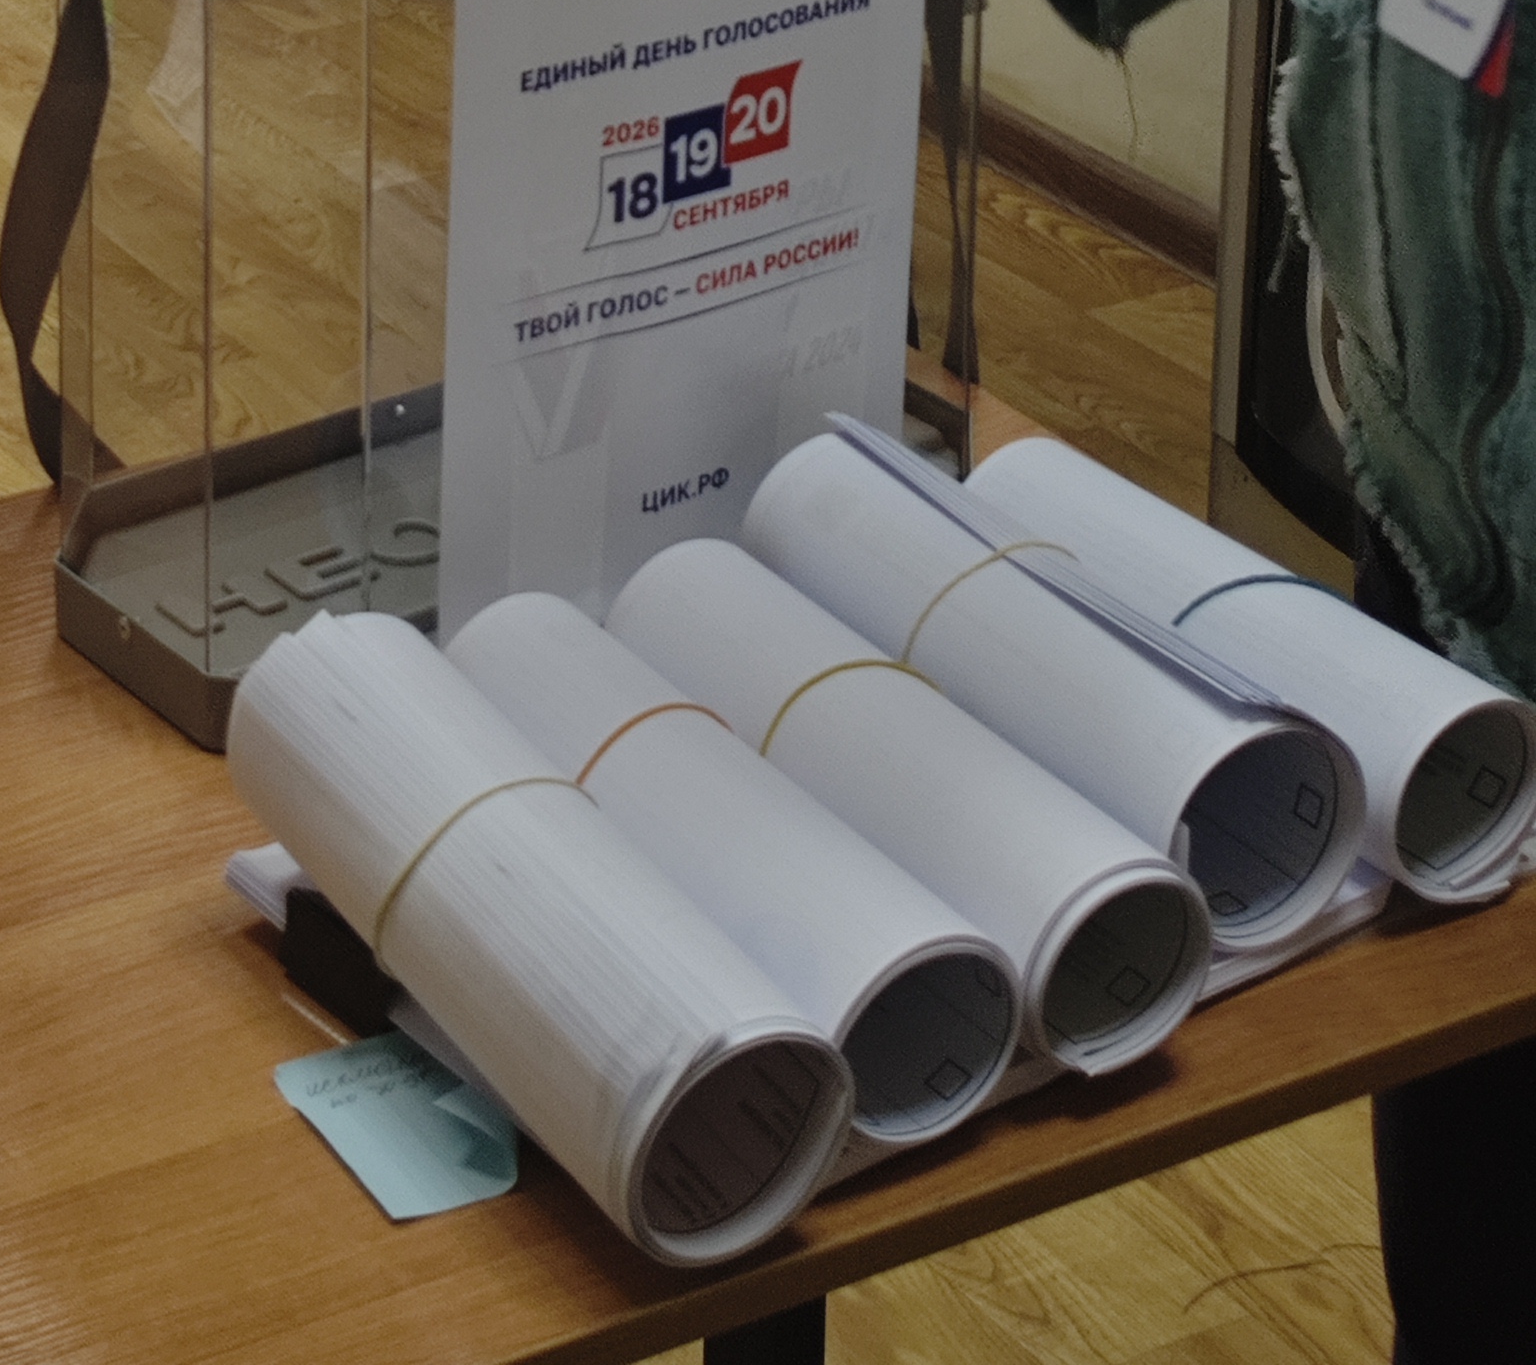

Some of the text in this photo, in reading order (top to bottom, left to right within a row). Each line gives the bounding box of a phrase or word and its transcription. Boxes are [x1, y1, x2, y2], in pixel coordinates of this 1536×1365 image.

[520, 43, 625, 93] ЕДИНЫЙ
[632, 34, 696, 69] ДЕНЬ
[601, 116, 660, 148] 2026
[607, 85, 788, 223] 18 19 20
[673, 180, 790, 231] СЕНТЯБРЯ
[514, 303, 580, 342] ТВОЙ
[587, 286, 668, 323] ГОЛОС
[695, 261, 757, 295] СИЛА
[764, 228, 860, 275] РОССИИ!
[642, 467, 730, 512] ЦИК.РФ
